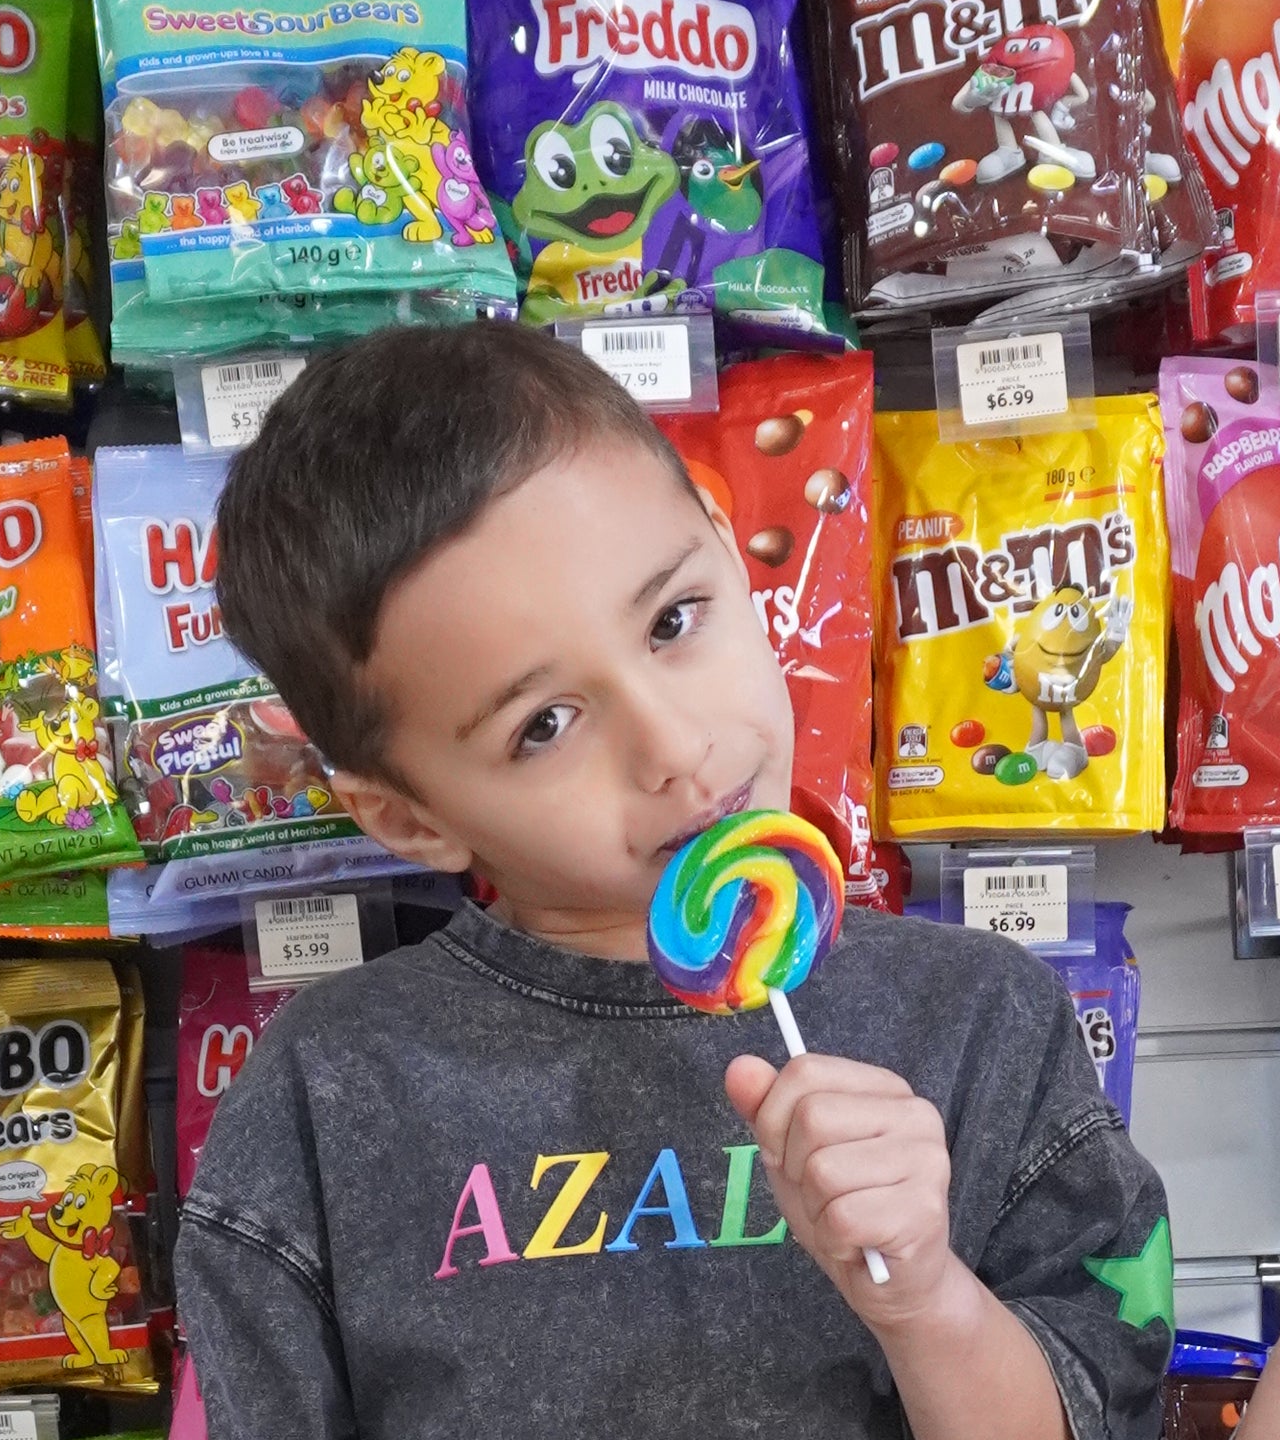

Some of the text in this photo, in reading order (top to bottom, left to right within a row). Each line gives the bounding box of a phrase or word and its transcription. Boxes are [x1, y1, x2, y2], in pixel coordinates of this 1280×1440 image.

[1234, 451, 1275, 477] FLAVOUR
[898, 516, 953, 542] PEANUT
[158, 722, 226, 752] Sweet
[158, 740, 242, 778] Playful
[282, 940, 330, 959] $5.99
[434, 1143, 788, 1280] AZAL
